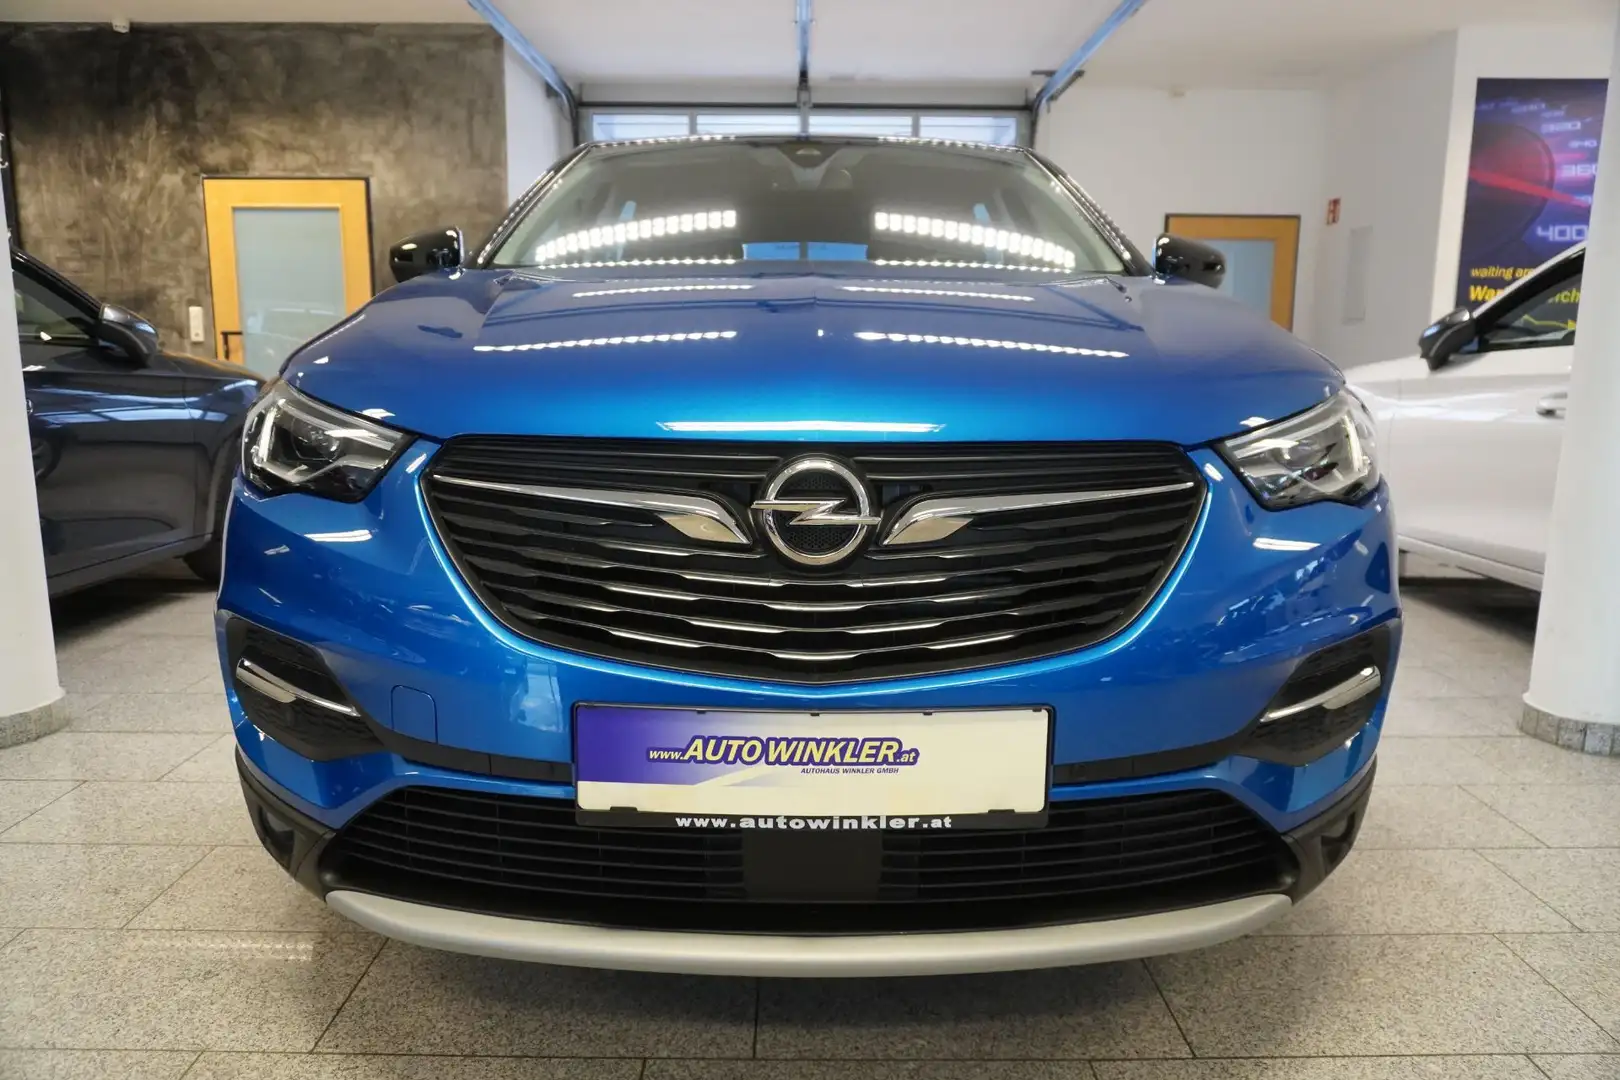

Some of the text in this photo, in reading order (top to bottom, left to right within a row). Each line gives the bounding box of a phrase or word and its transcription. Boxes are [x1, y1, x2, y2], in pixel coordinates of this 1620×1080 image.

[1536, 224, 1588, 242] 400
[1470, 265, 1514, 280] waiting
[800, 767, 899, 775] AUTOHAUS WINKLER GMBH
[675, 815, 952, 830] www.autowinkler.at
